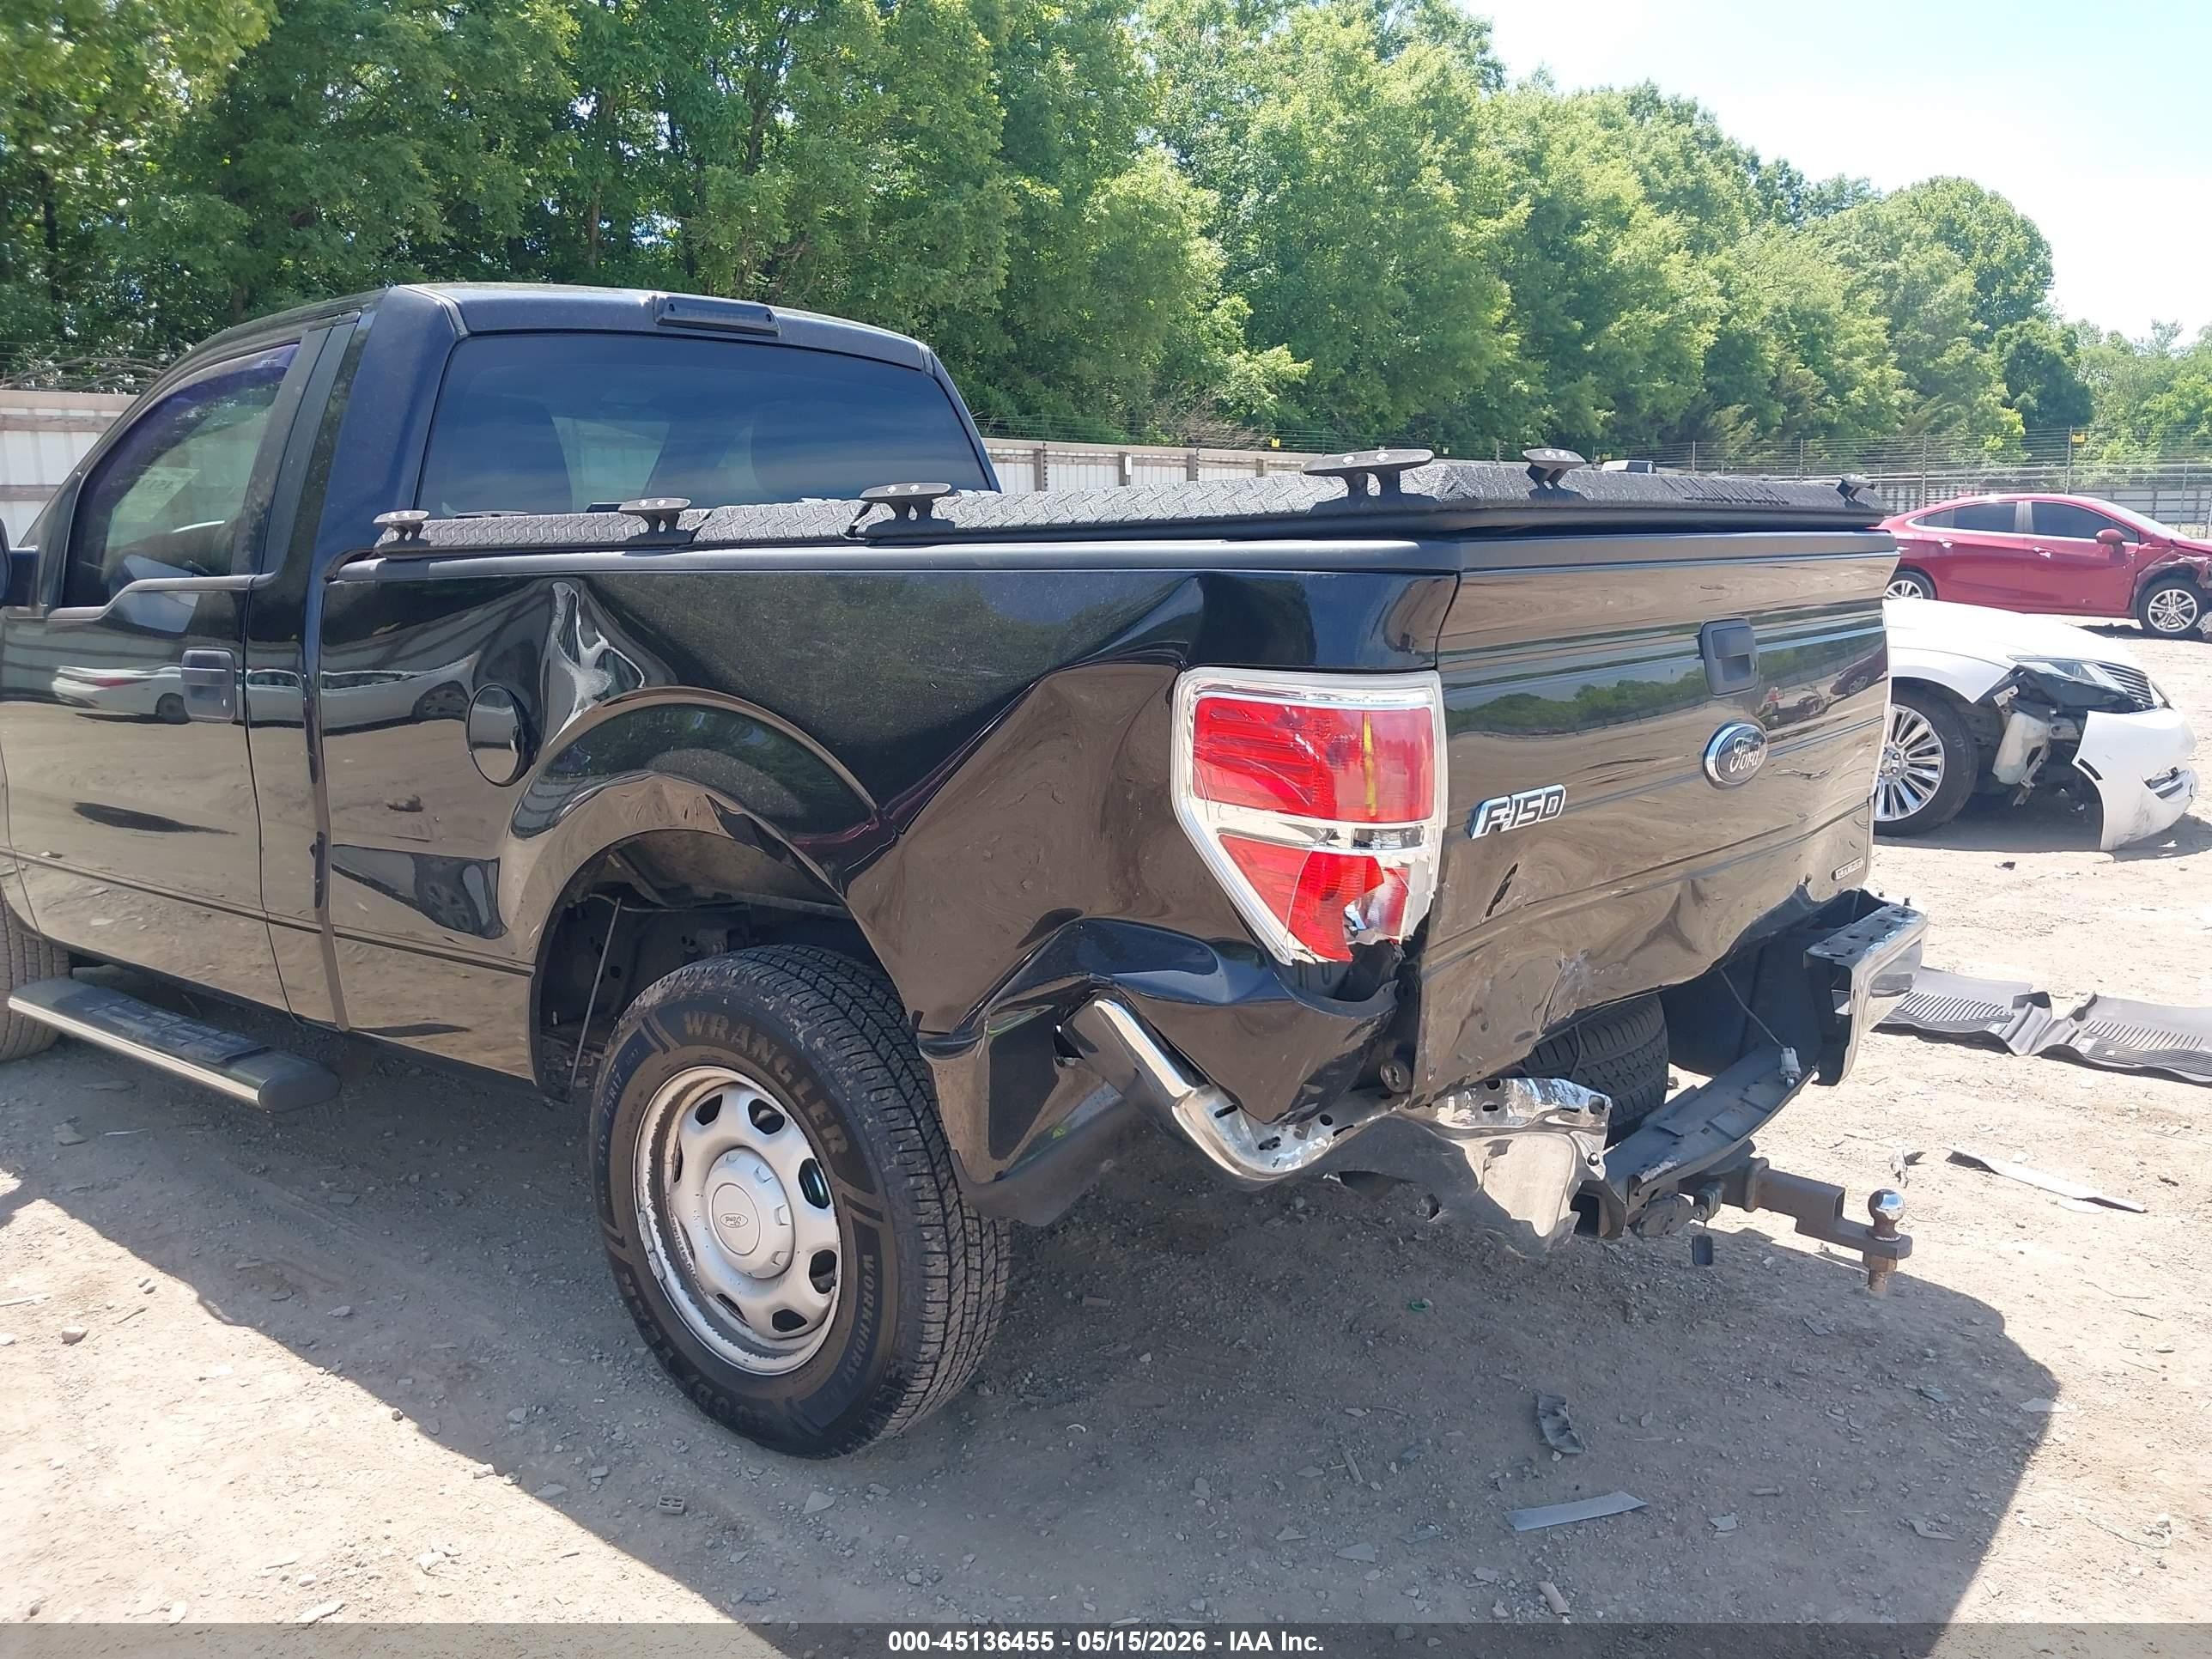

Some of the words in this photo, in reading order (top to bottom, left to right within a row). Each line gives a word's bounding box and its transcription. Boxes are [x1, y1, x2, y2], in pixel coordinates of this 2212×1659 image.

[1729, 735, 1761, 773] Ford
[1471, 783, 1565, 839] F-150
[682, 1009, 849, 1158] WRANGLER
[840, 1251, 875, 1389] WORKHORSE
